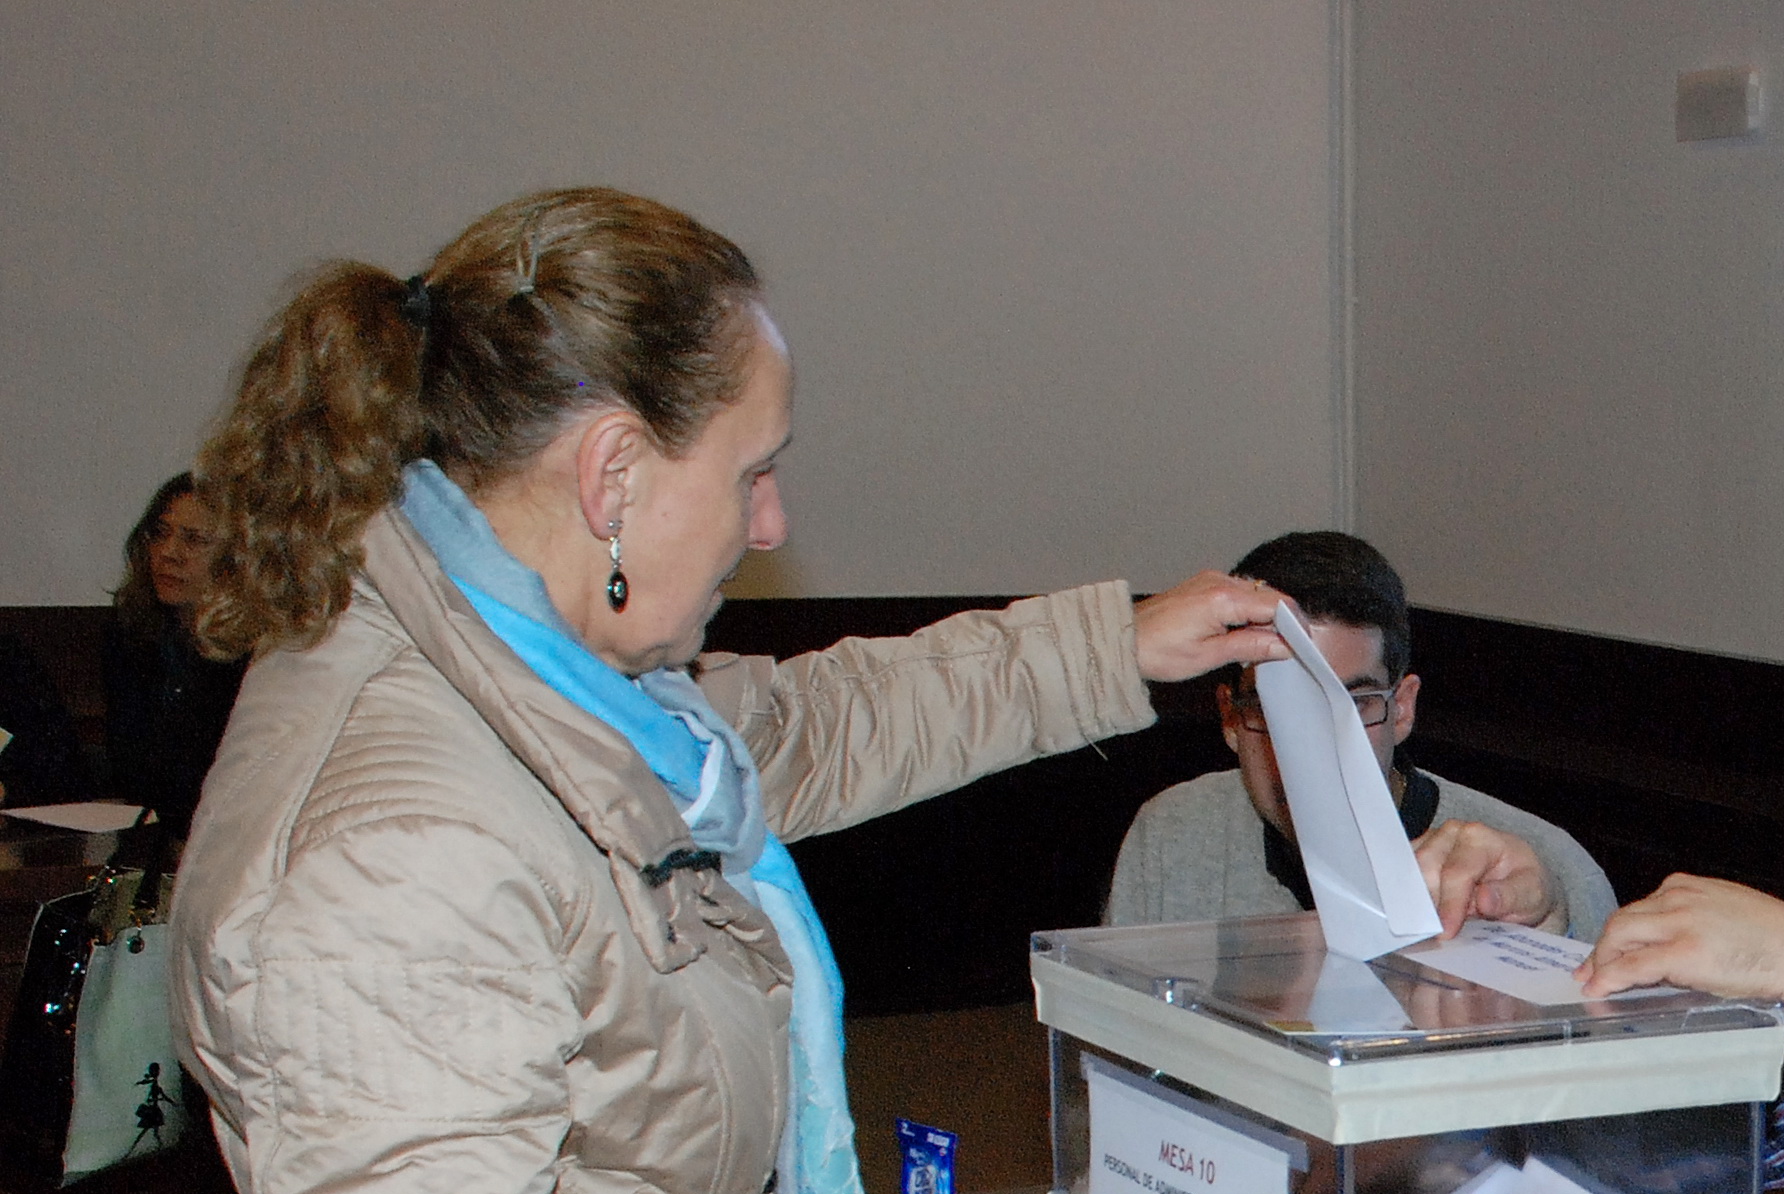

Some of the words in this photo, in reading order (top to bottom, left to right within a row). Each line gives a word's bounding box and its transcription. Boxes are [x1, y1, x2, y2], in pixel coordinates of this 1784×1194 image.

[1103, 1153, 1141, 1185] PERSONAL
[1142, 1172, 1153, 1190] DE
[1158, 1140, 1194, 1176] MESA
[1199, 1158, 1216, 1185] 10
